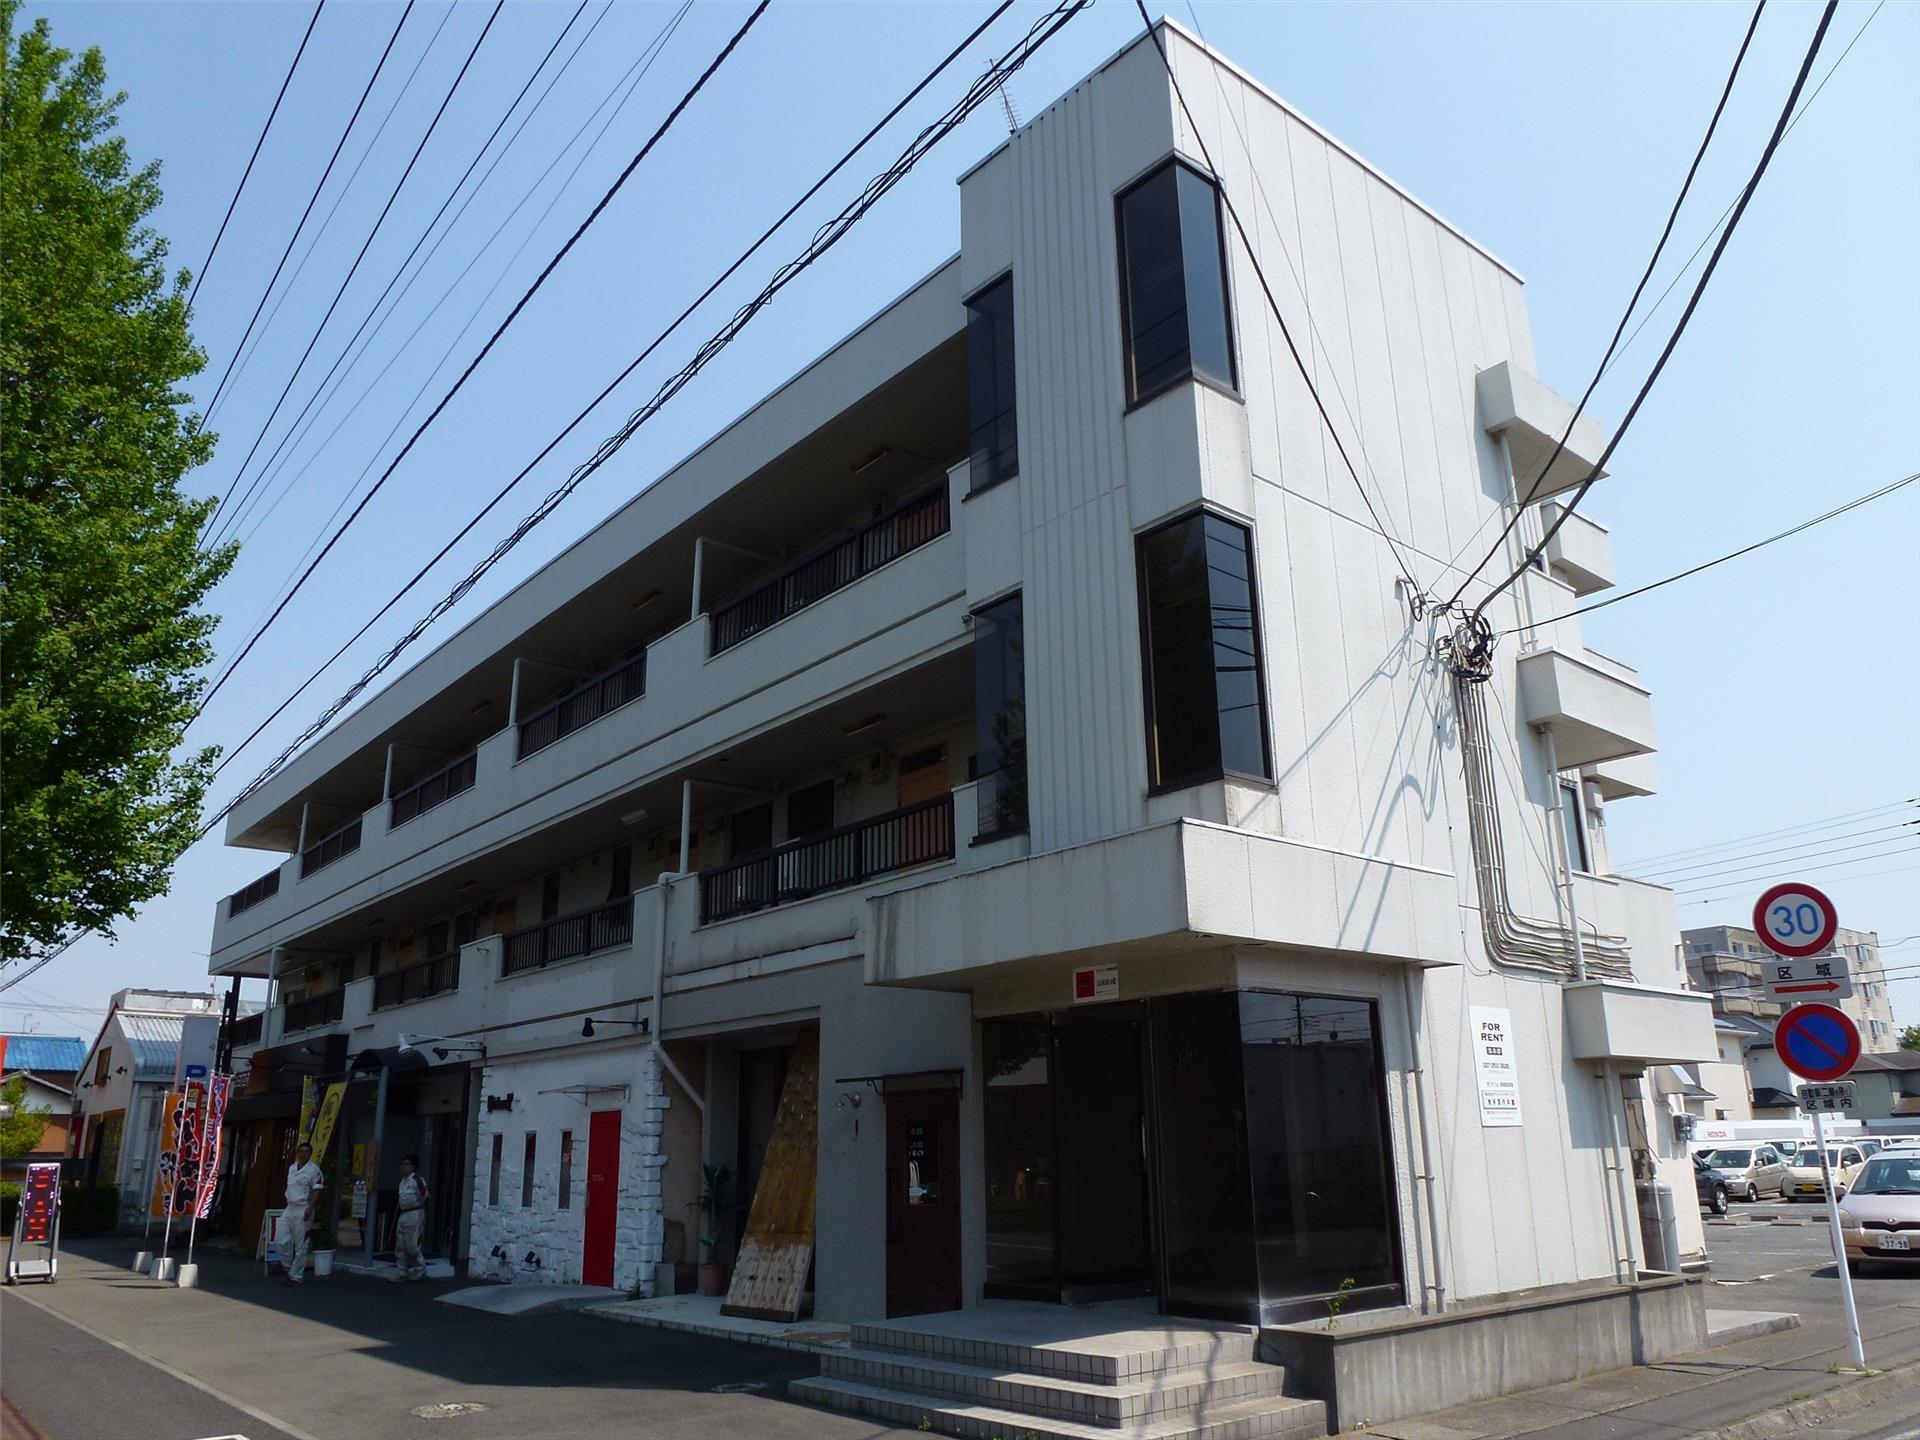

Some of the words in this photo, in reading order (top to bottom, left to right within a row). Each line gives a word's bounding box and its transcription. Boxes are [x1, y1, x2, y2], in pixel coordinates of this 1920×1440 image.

[1772, 903, 1819, 937] 30
[1777, 963, 1832, 979] 区域
[1482, 1022, 1500, 1031] FOR
[1481, 1033, 1504, 1042] RENT
[1806, 1098, 1853, 1110] 区域内
